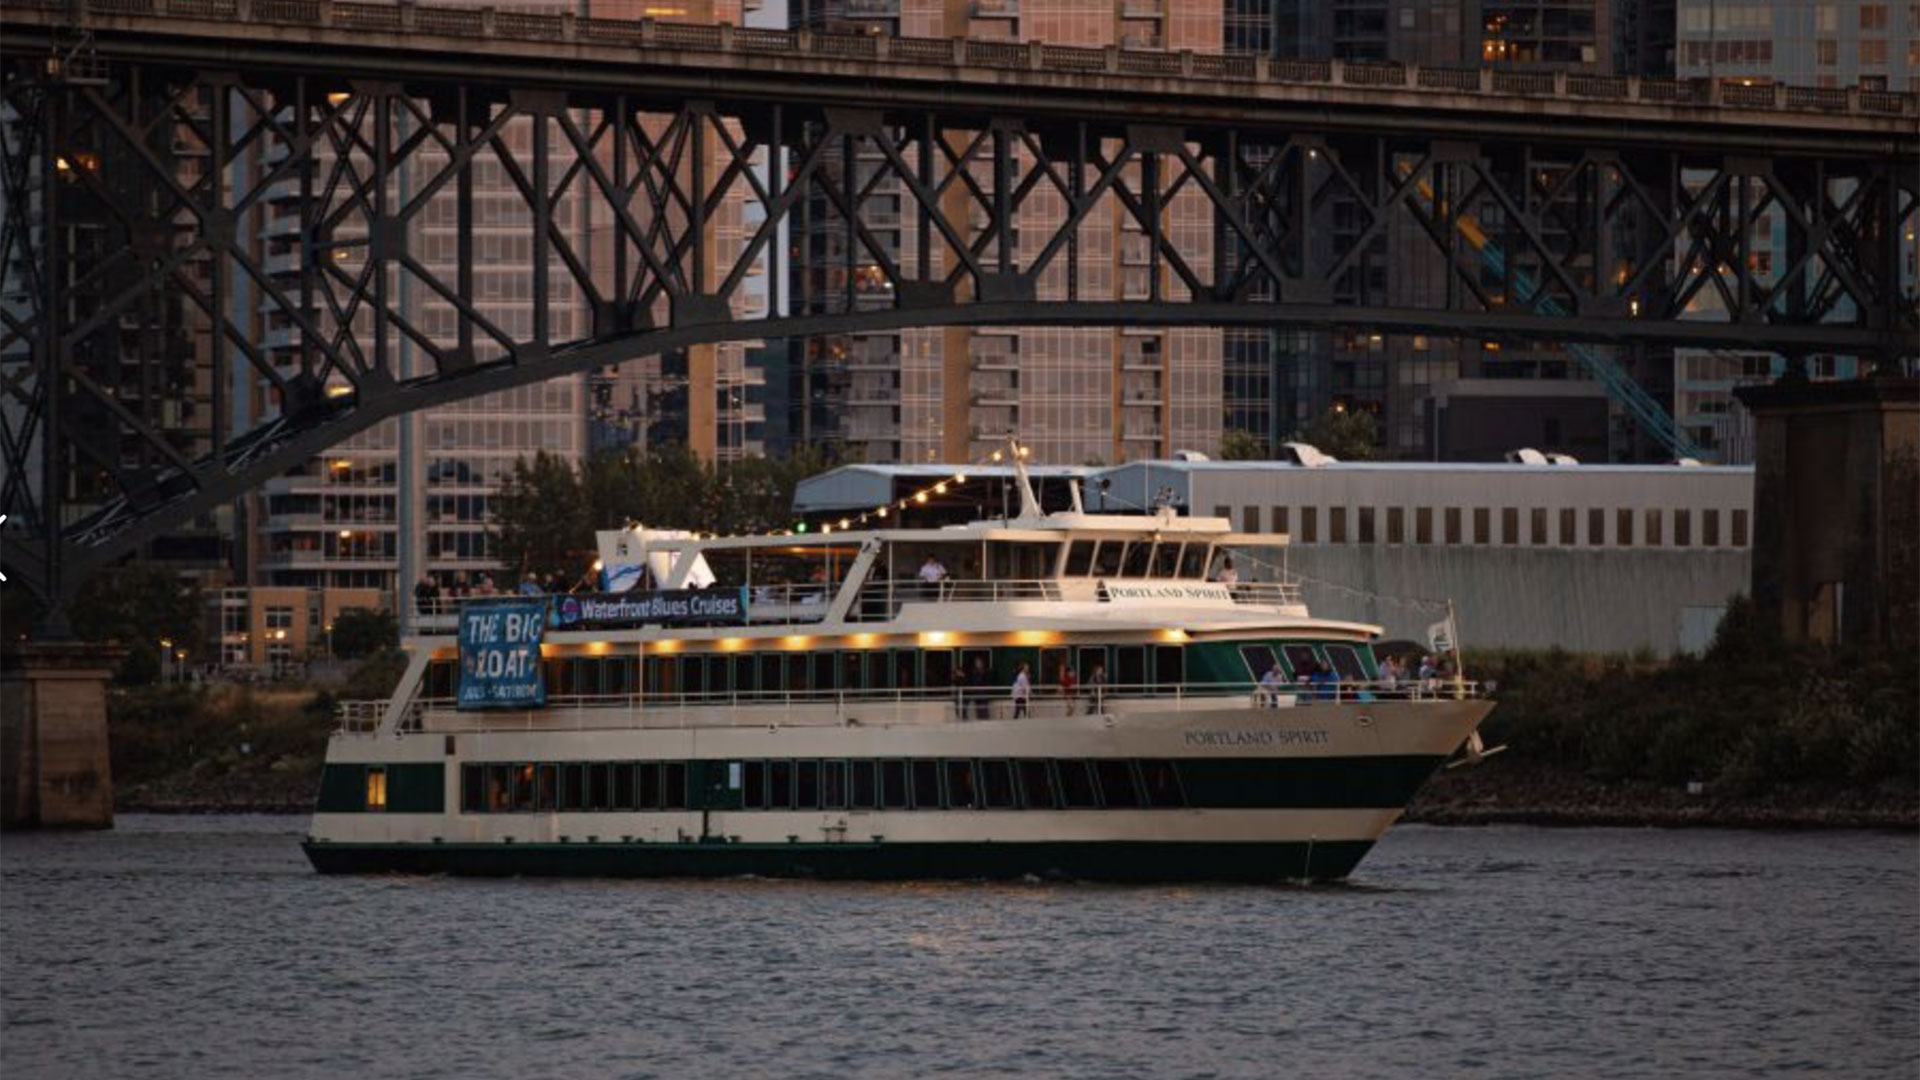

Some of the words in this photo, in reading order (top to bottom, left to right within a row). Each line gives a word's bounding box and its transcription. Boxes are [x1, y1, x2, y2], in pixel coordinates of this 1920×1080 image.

[1109, 586, 1183, 599] PORTLAND
[1185, 587, 1229, 600] SPIRIT
[581, 598, 650, 619] Waterfront
[651, 597, 687, 616] Blues
[690, 595, 737, 615] Cruises
[467, 614, 500, 644] THE
[505, 612, 542, 642] BIG
[1184, 730, 1273, 745] PORTLAND
[1278, 729, 1329, 744] SPIRIT
